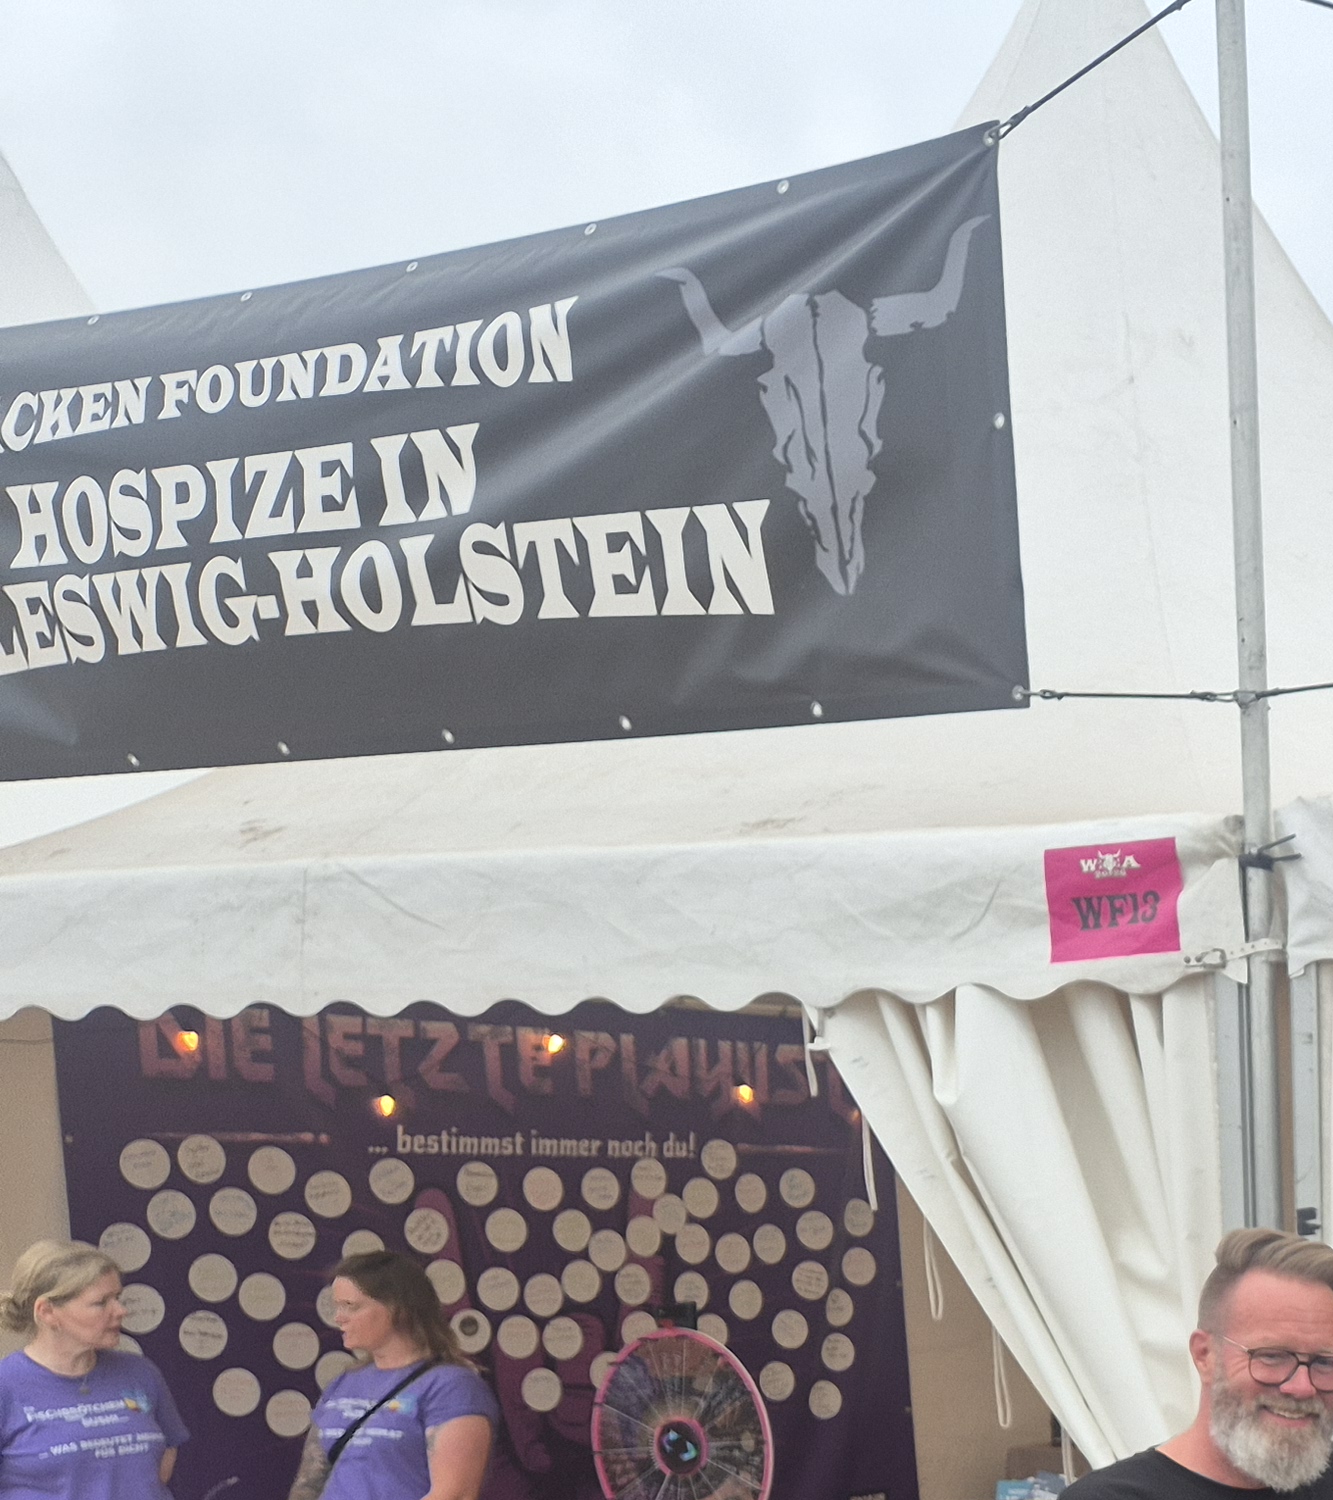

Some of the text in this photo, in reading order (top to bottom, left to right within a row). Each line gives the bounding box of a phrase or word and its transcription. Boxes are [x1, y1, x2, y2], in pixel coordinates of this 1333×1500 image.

[0, 294, 579, 451] CKEN FOUNDATION
[5, 422, 479, 569] HOSPIZE IN
[1071, 890, 1161, 932] WF13
[397, 1125, 524, 1156] bestimmst
[530, 1130, 602, 1157] immer
[607, 1131, 655, 1158] noch
[663, 1131, 697, 1158] du!
